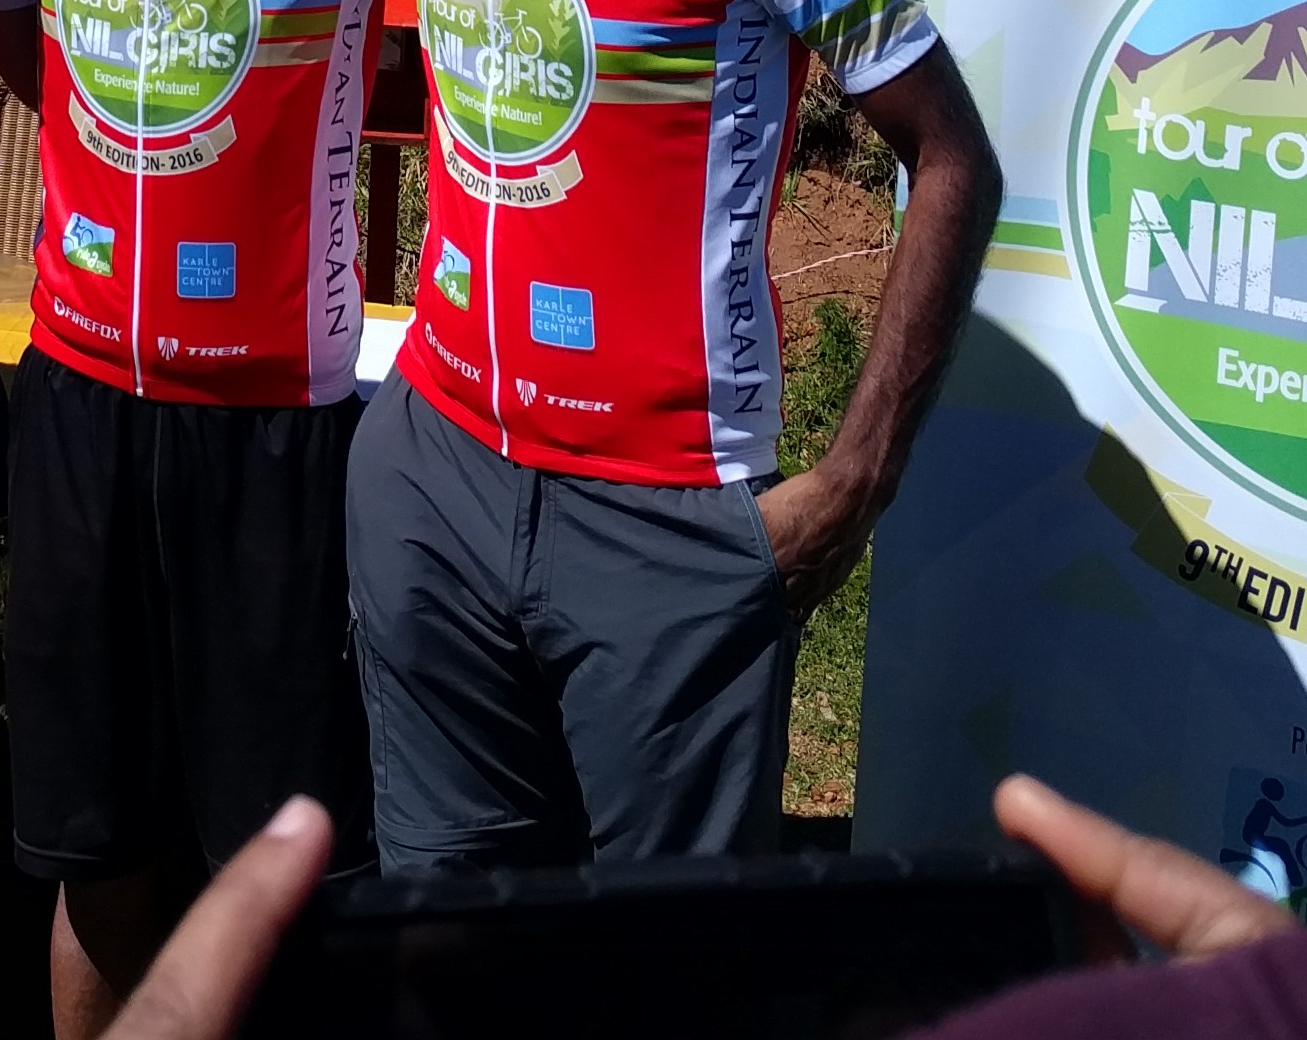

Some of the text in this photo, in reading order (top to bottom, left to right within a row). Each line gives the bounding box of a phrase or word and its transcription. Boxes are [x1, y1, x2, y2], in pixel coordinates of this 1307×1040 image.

[459, 9, 477, 30] of
[70, 12, 237, 75] NILGIRIS
[433, 23, 575, 101] NILGIRIS
[94, 67, 200, 97] Experiene Nature!
[454, 85, 542, 126] Experiene Nature!
[1133, 96, 1252, 171] tour
[86, 129, 104, 154] 9th
[169, 147, 204, 171] 2016
[517, 181, 551, 204] 2016
[727, 17, 769, 415] INDIAN TERRAIN
[324, 131, 354, 338] TERRAIN
[182, 257, 219, 267] KARLE
[196, 267, 230, 276] TOWN
[181, 276, 223, 287] CENTRE
[536, 298, 573, 314] KARLE
[551, 312, 587, 326] TOWN
[65, 306, 122, 343] FIREFOX
[535, 320, 580, 336] CENTRE
[185, 344, 250, 358] TREK
[432, 335, 482, 383] FIREFOX
[543, 393, 614, 413] TREK
[1178, 539, 1244, 584] 9TH
